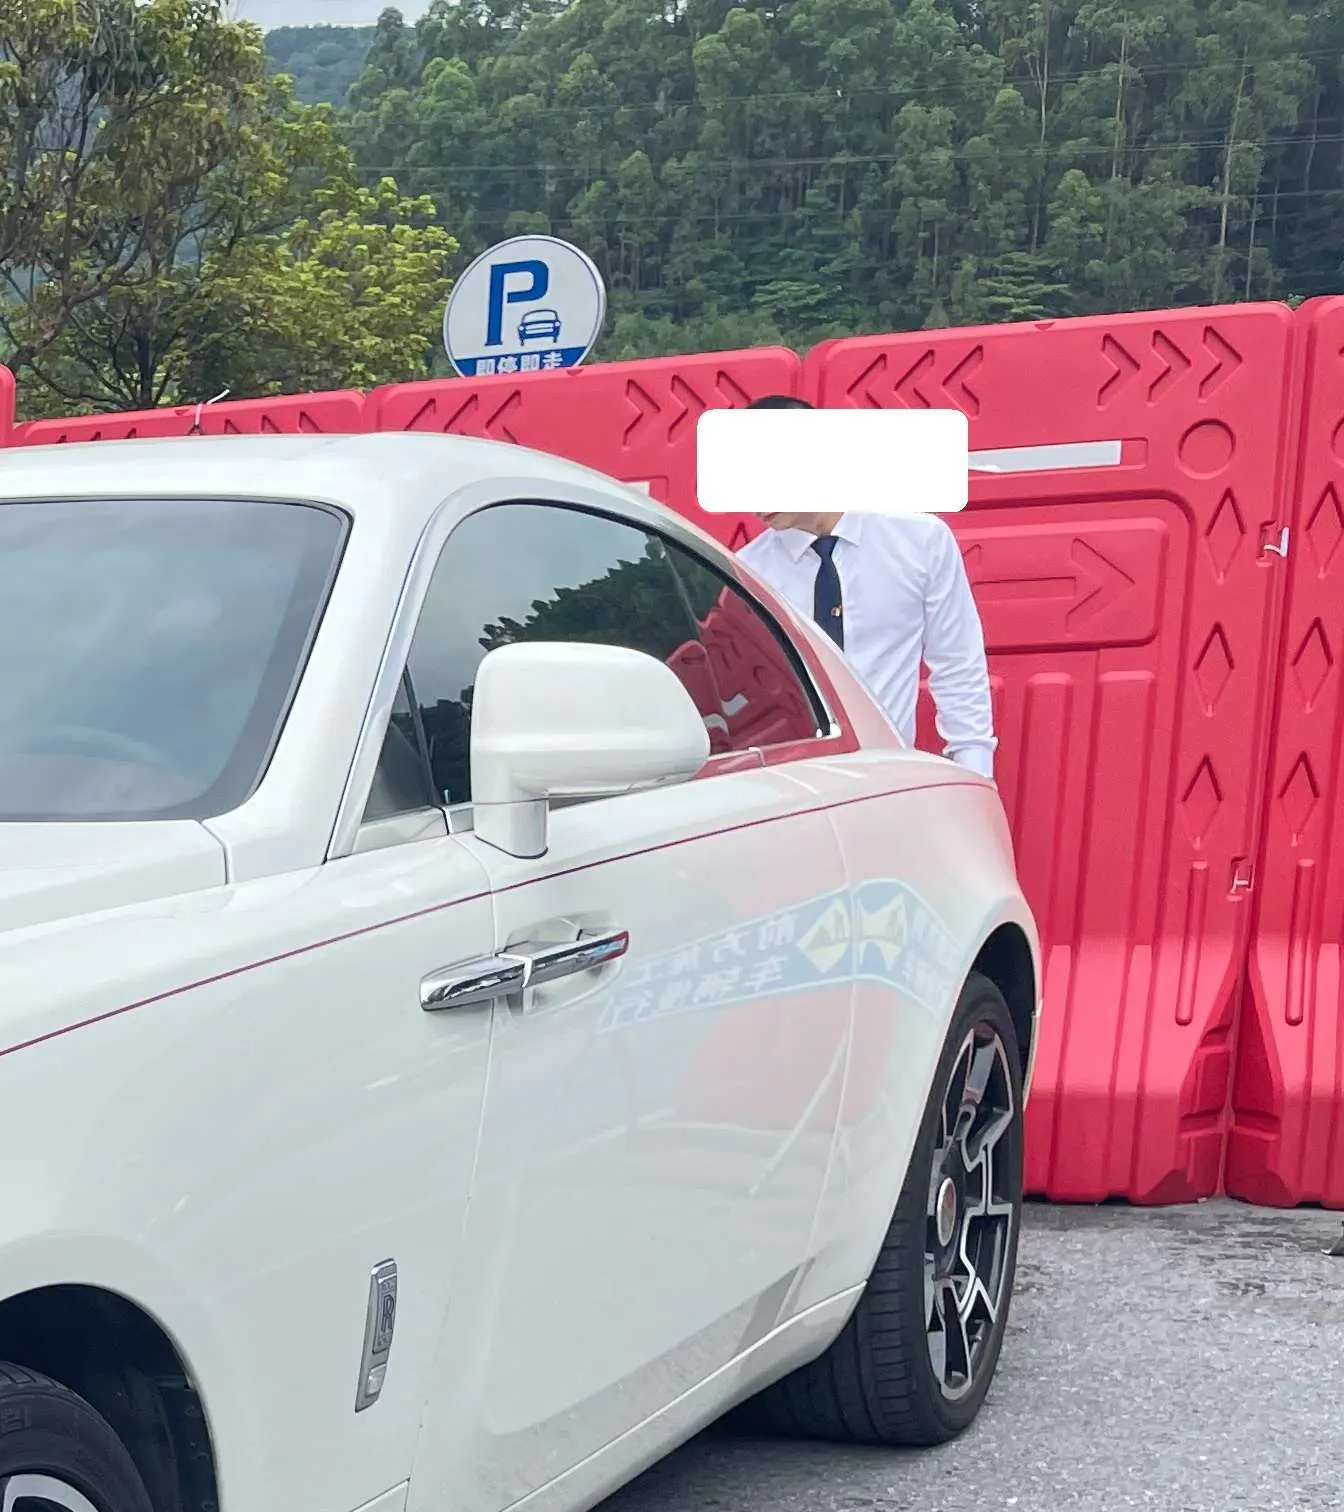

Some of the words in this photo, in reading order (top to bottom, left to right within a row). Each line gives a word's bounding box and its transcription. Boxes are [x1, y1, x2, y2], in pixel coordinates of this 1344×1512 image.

[484, 259, 549, 346] P
[476, 352, 563, 376] 即停即走
